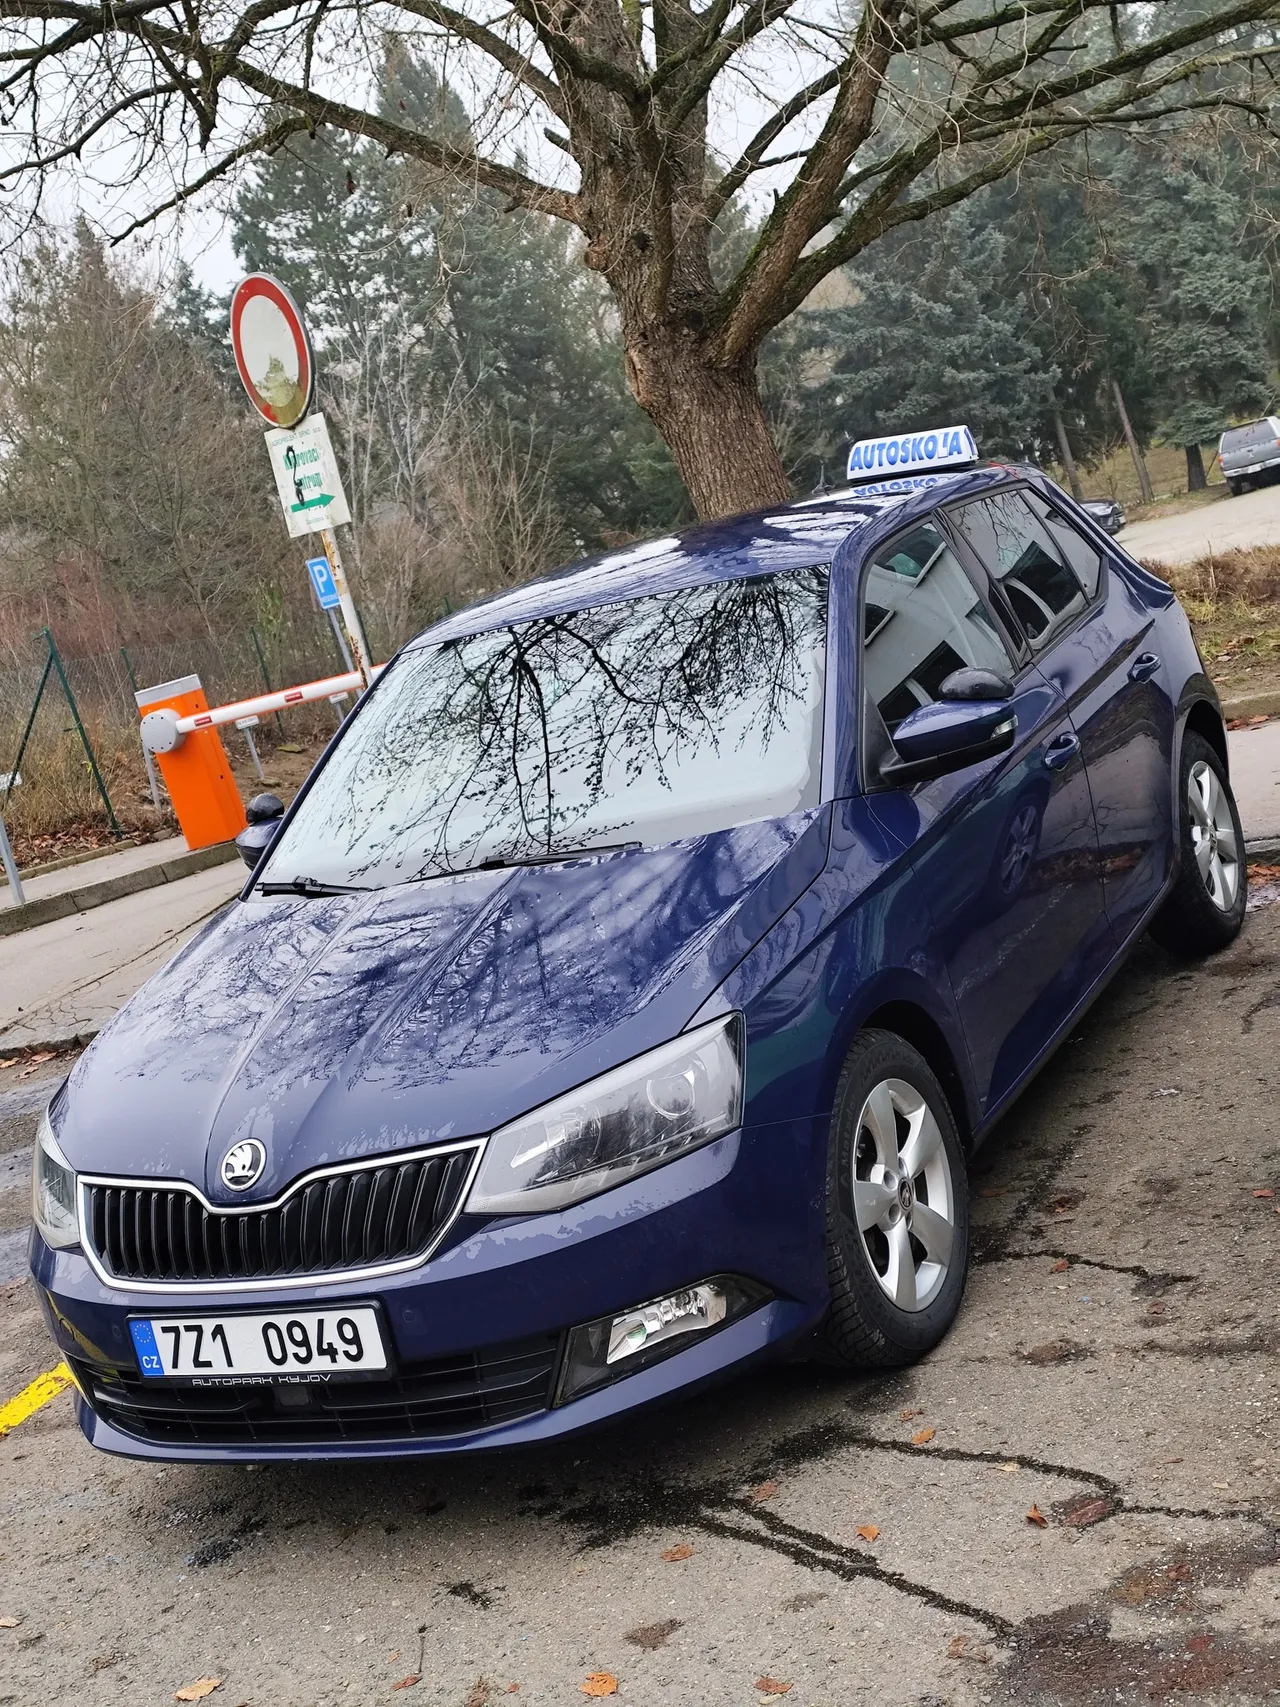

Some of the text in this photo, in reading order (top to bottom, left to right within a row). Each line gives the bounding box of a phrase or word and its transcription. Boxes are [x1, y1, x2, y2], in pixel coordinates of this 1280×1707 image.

[313, 565, 327, 593] P
[141, 1317, 364, 1369] CZ 7Z1 0949
[192, 1374, 331, 1386] AUTOPARK KYJOV
